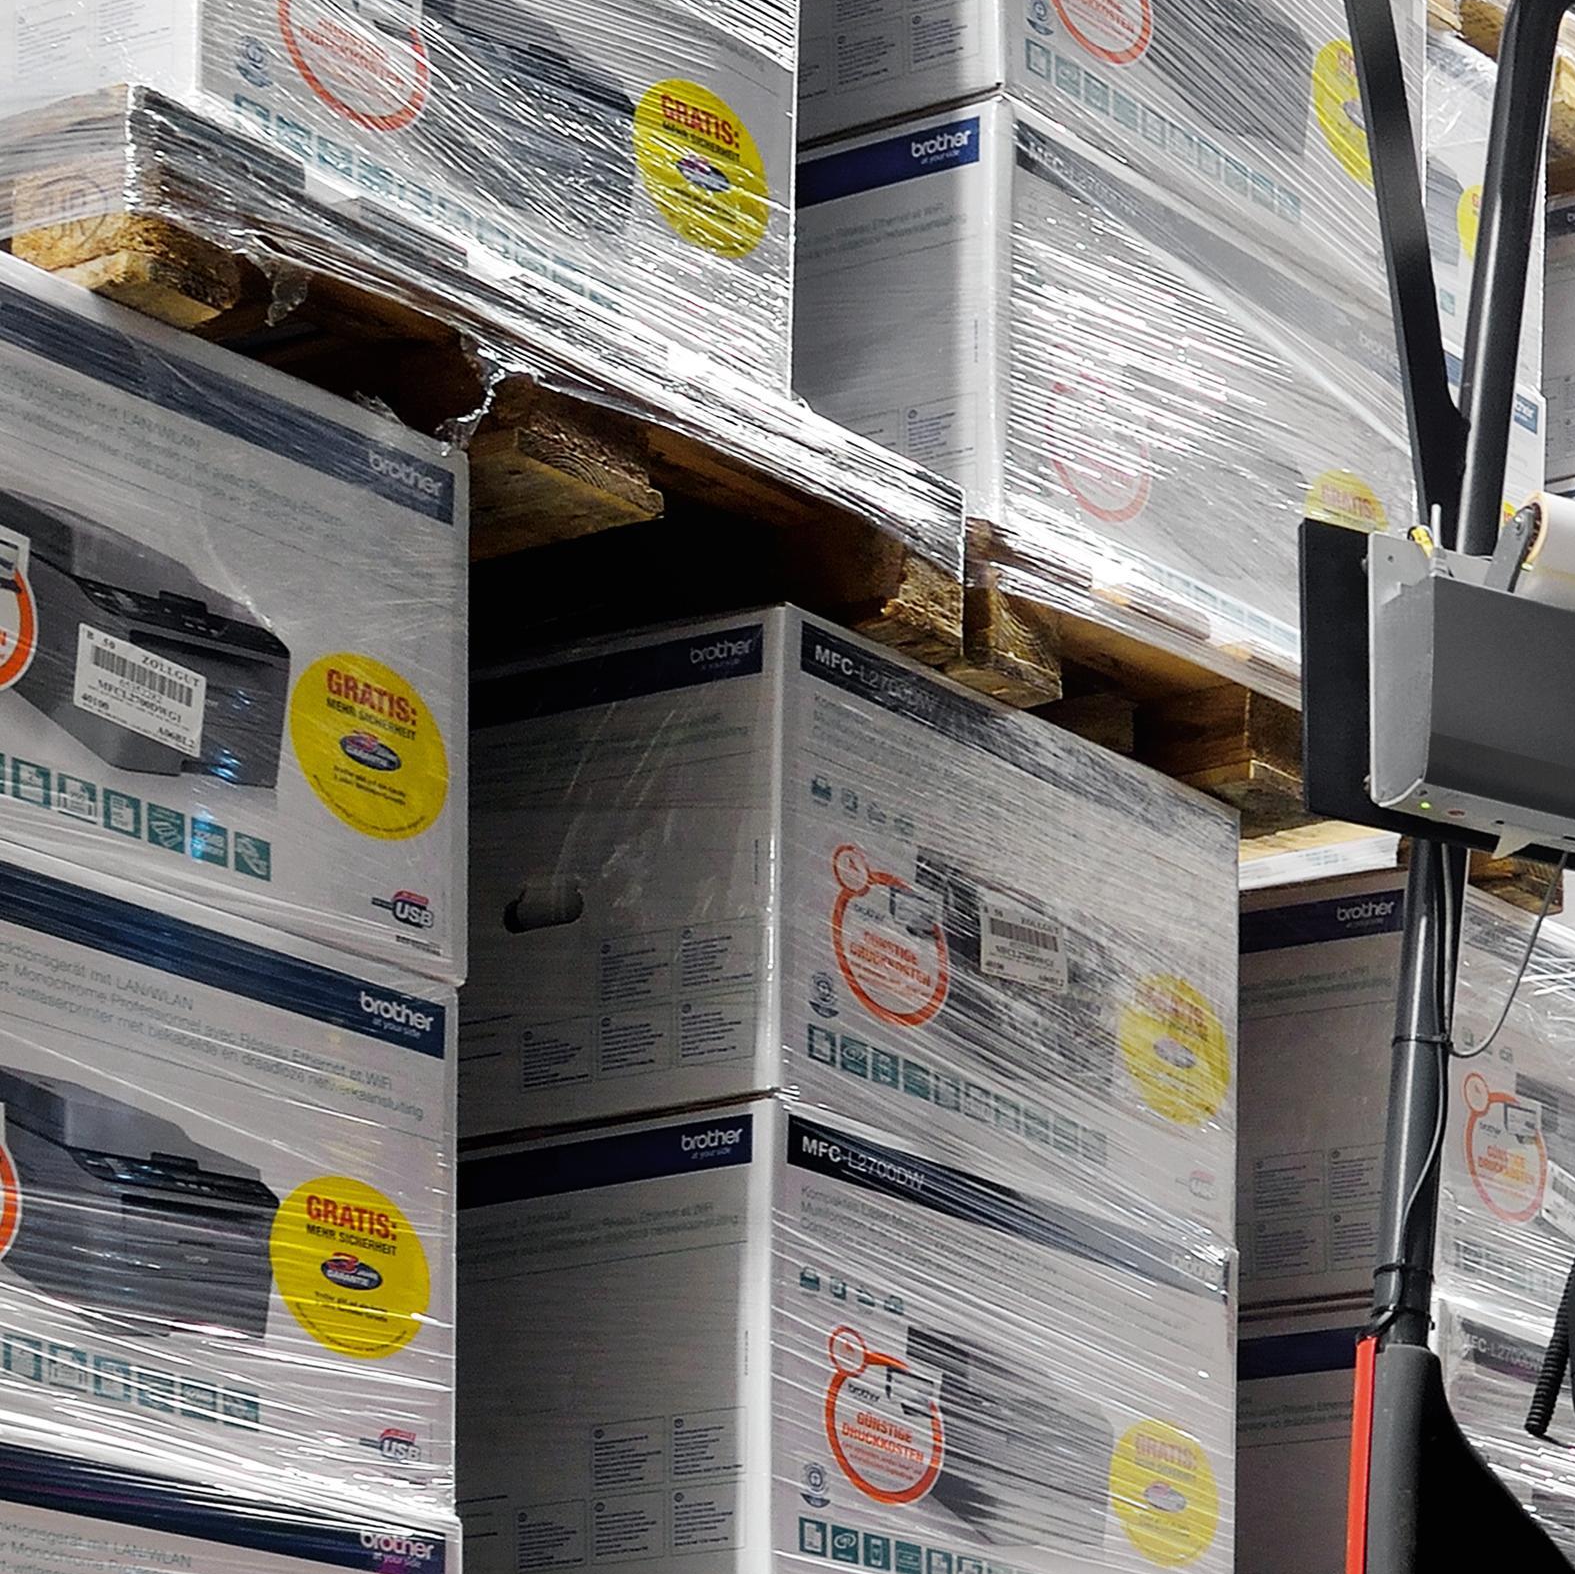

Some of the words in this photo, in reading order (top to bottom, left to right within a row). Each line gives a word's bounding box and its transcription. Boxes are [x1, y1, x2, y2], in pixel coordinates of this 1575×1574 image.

[660, 94, 742, 150] GRATIS:
[910, 125, 972, 158] brother
[368, 450, 444, 498] brother
[689, 635, 754, 666] brother
[140, 654, 200, 688] ZOLLGUT
[326, 667, 418, 727] GRATIS:
[394, 899, 434, 928] USB
[1335, 899, 1396, 924] brother
[359, 990, 435, 1032] brother
[681, 1126, 744, 1155] brother
[801, 1133, 926, 1192] MFC-L2700DW
[306, 1194, 398, 1242] GRATIS:
[306, 1223, 336, 1242] MEHR
[338, 1231, 398, 1257] SICHERHEIT
[841, 1420, 926, 1465] DRUCKKOSTEN
[856, 1410, 914, 1444] GÜNSTIGE
[381, 1436, 422, 1464] USB
[359, 1527, 436, 1560] brother
